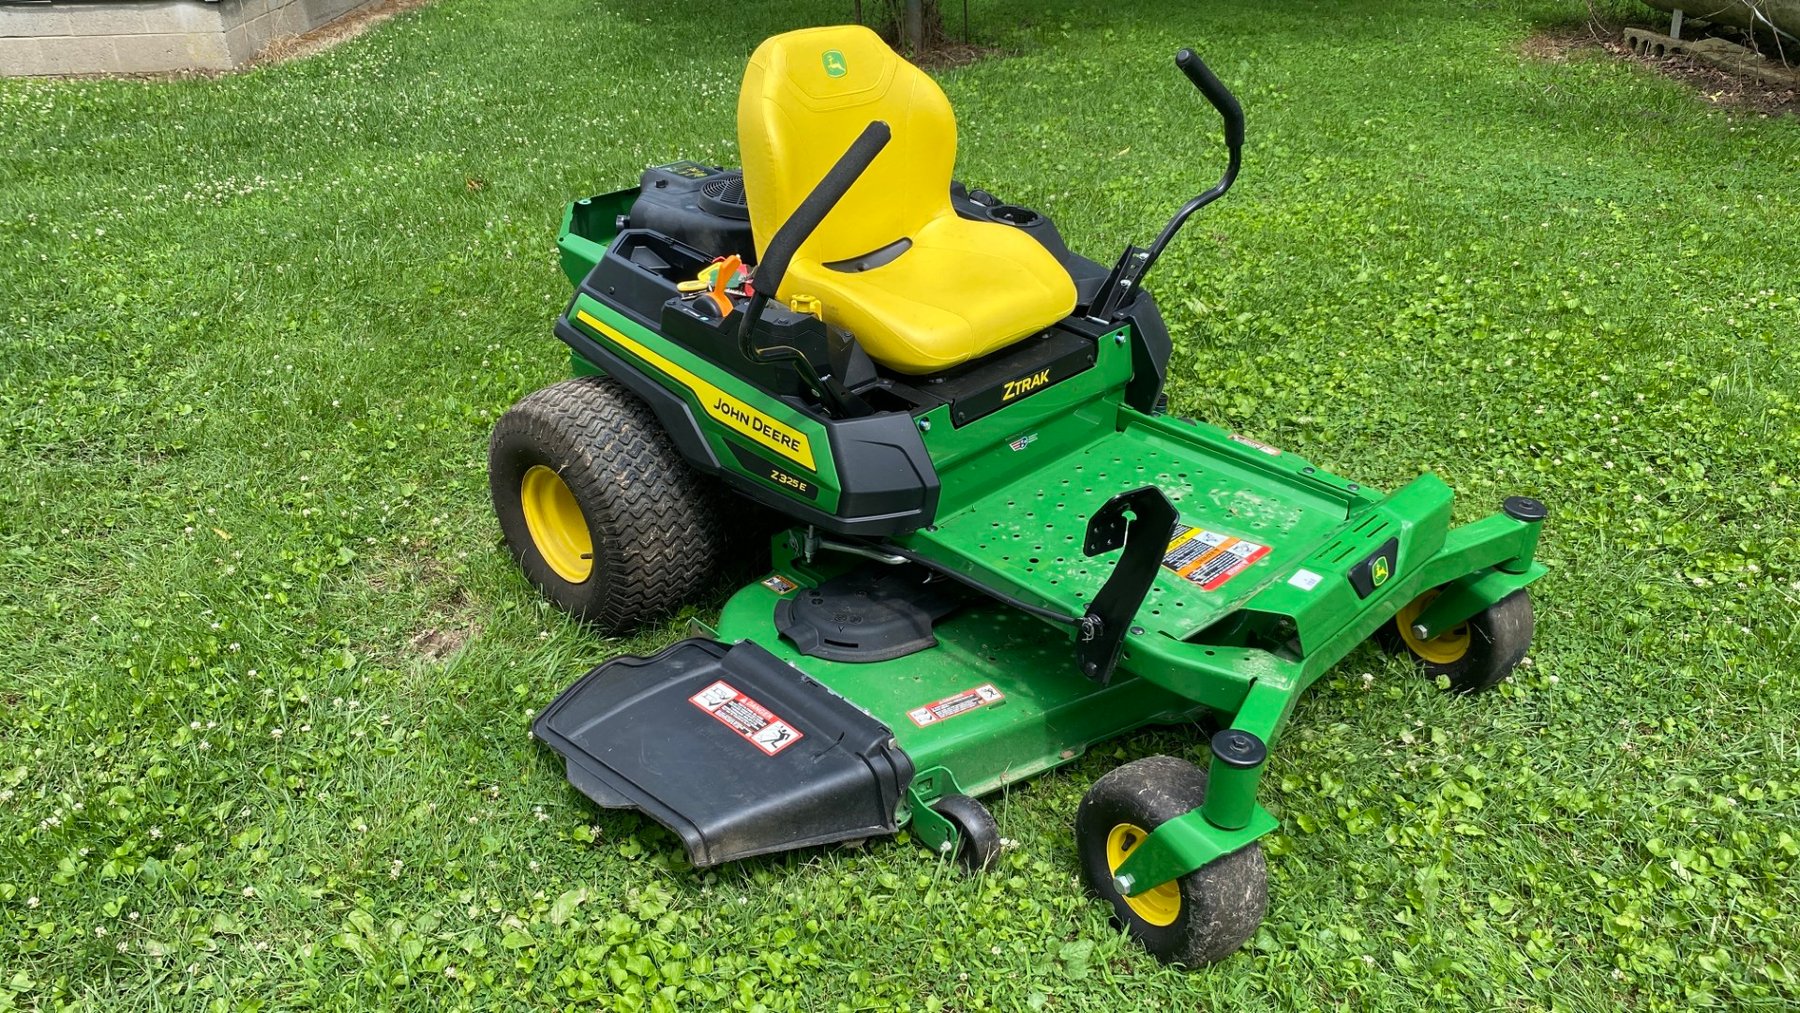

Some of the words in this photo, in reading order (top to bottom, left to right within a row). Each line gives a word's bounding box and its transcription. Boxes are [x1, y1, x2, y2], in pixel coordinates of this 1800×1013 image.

[1003, 368, 1050, 401] ZTRAK
[713, 397, 750, 426] JOHN
[752, 416, 801, 453] DEERE
